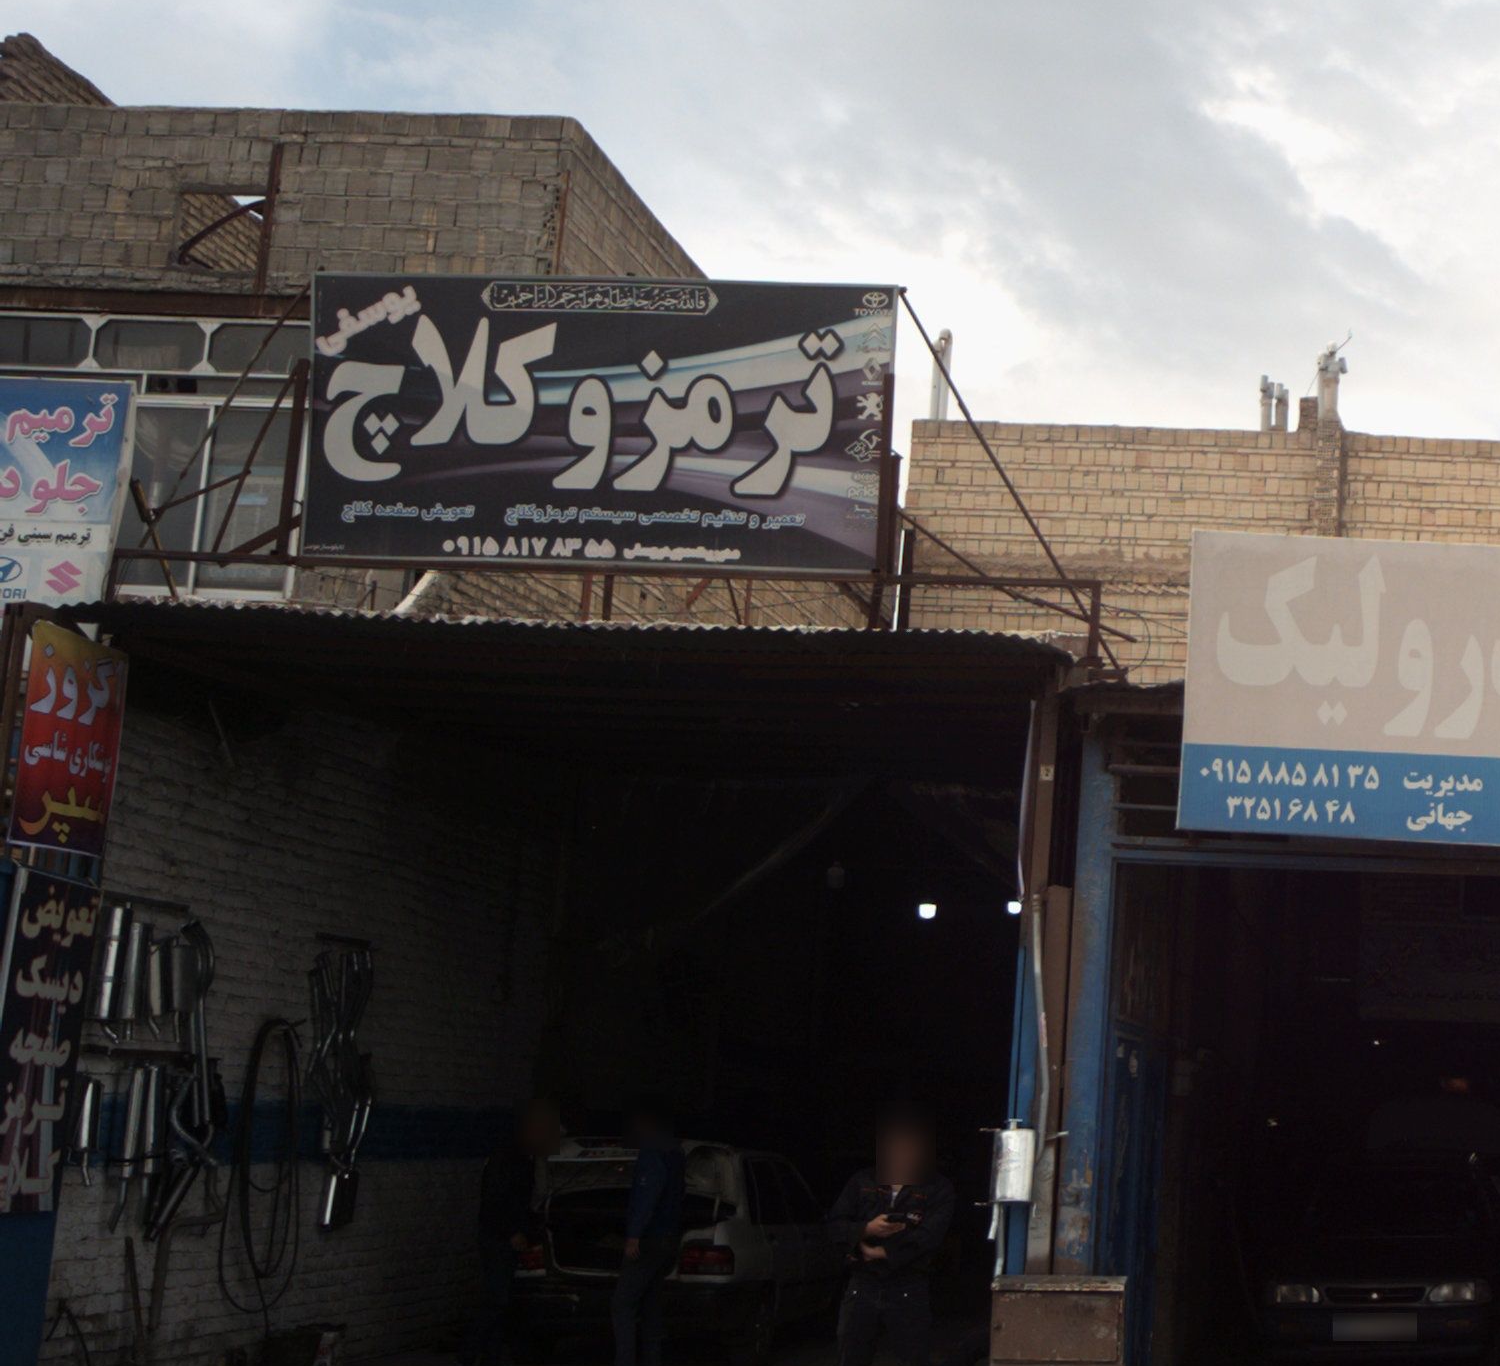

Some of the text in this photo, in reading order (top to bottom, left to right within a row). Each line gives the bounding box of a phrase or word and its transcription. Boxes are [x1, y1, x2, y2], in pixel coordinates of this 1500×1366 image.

[322, 313, 557, 482] کلاچ
[6, 393, 118, 446] ترمیم
[340, 500, 475, 522] تعویض صفحه کلاچ
[578, 508, 636, 524] سیستم
[638, 508, 700, 526] تخصصی
[701, 509, 746, 527] تنظیم
[748, 514, 759, 527] و
[763, 511, 806, 528] تعمیر
[18, 526, 52, 544] سینی
[55, 527, 92, 546] ترمیم
[442, 536, 499, 556] ۰۹۱۵
[502, 536, 547, 556] ۸۱۷
[550, 537, 582, 556] ۸۳
[583, 537, 617, 557] ۵۵
[0, 588, 26, 599] DAI
[25, 731, 68, 766] شاسی
[1200, 757, 1379, 790] ۰۹۱۵ ۸۸۵ ۸۱ ۳۵
[1402, 770, 1484, 797] مدیریت
[1226, 796, 1356, 824] ۳۲۵۱ ۶۸ ۴۸
[1406, 802, 1473, 832] جهانی
[21, 885, 100, 948] تعویض
[15, 955, 84, 1015] دیسک
[9, 1025, 72, 1069] صفحه
